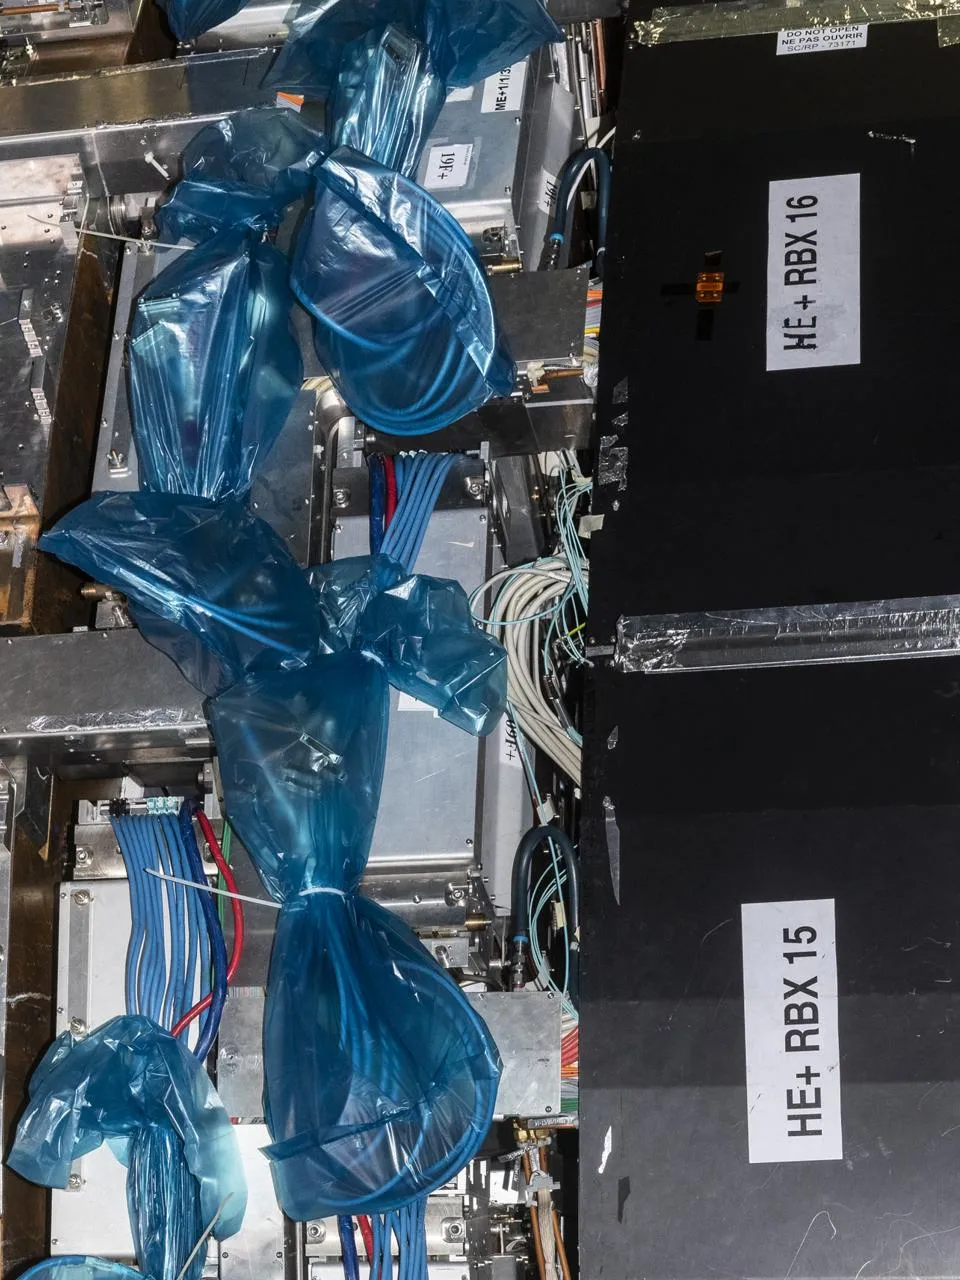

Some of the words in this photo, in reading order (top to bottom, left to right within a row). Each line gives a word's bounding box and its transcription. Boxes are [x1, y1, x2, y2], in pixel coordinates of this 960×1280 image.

[823, 32, 863, 41] OUVRIR
[829, 26, 859, 34] OPEN
[787, 43, 818, 52] SC/RP
[827, 40, 856, 48] 73171
[437, 152, 455, 180] 19F+
[785, 195, 818, 223] 16
[784, 229, 817, 286] RBX
[783, 926, 818, 964] 15
[783, 976, 820, 1053] RBX
[786, 1066, 823, 1137] HE+
